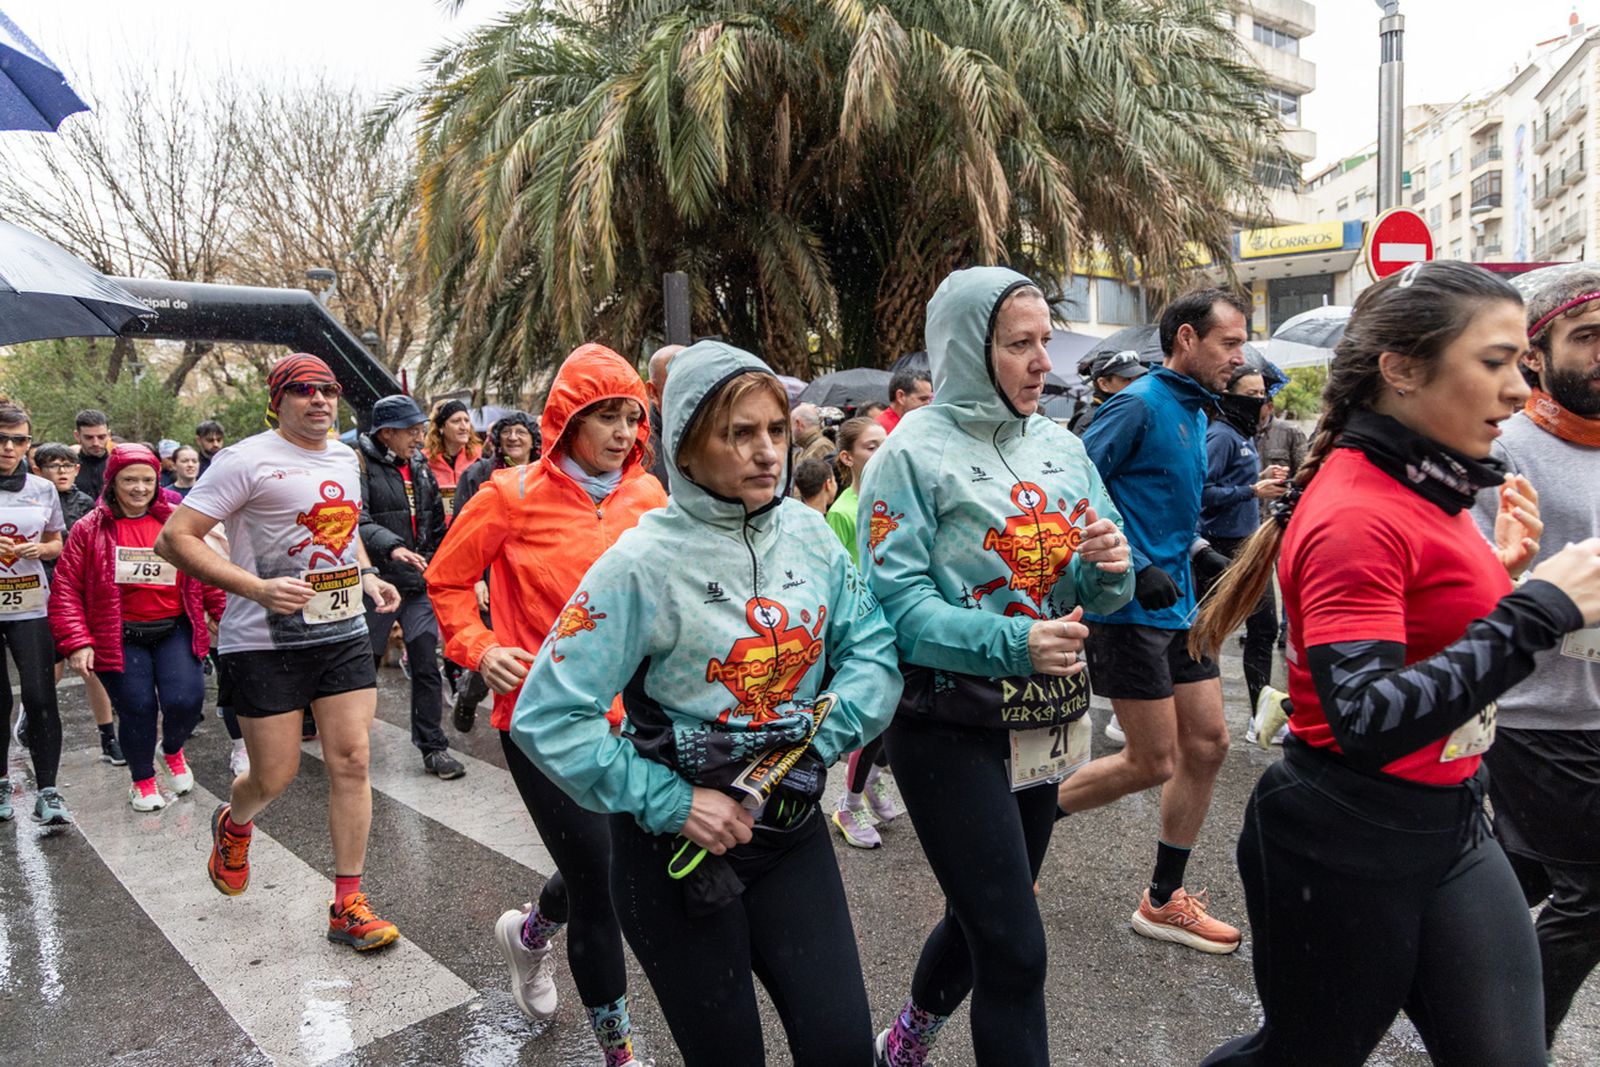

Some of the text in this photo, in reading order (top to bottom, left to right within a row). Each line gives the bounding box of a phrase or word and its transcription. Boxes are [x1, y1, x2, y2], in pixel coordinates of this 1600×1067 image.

[1269, 233, 1333, 249] CORREOS
[173, 299, 188, 309] de
[133, 562, 161, 577] 763
[2, 592, 22, 605] 25
[330, 589, 349, 610] 24
[1049, 724, 1070, 758] 21
[749, 767, 769, 782] IES
